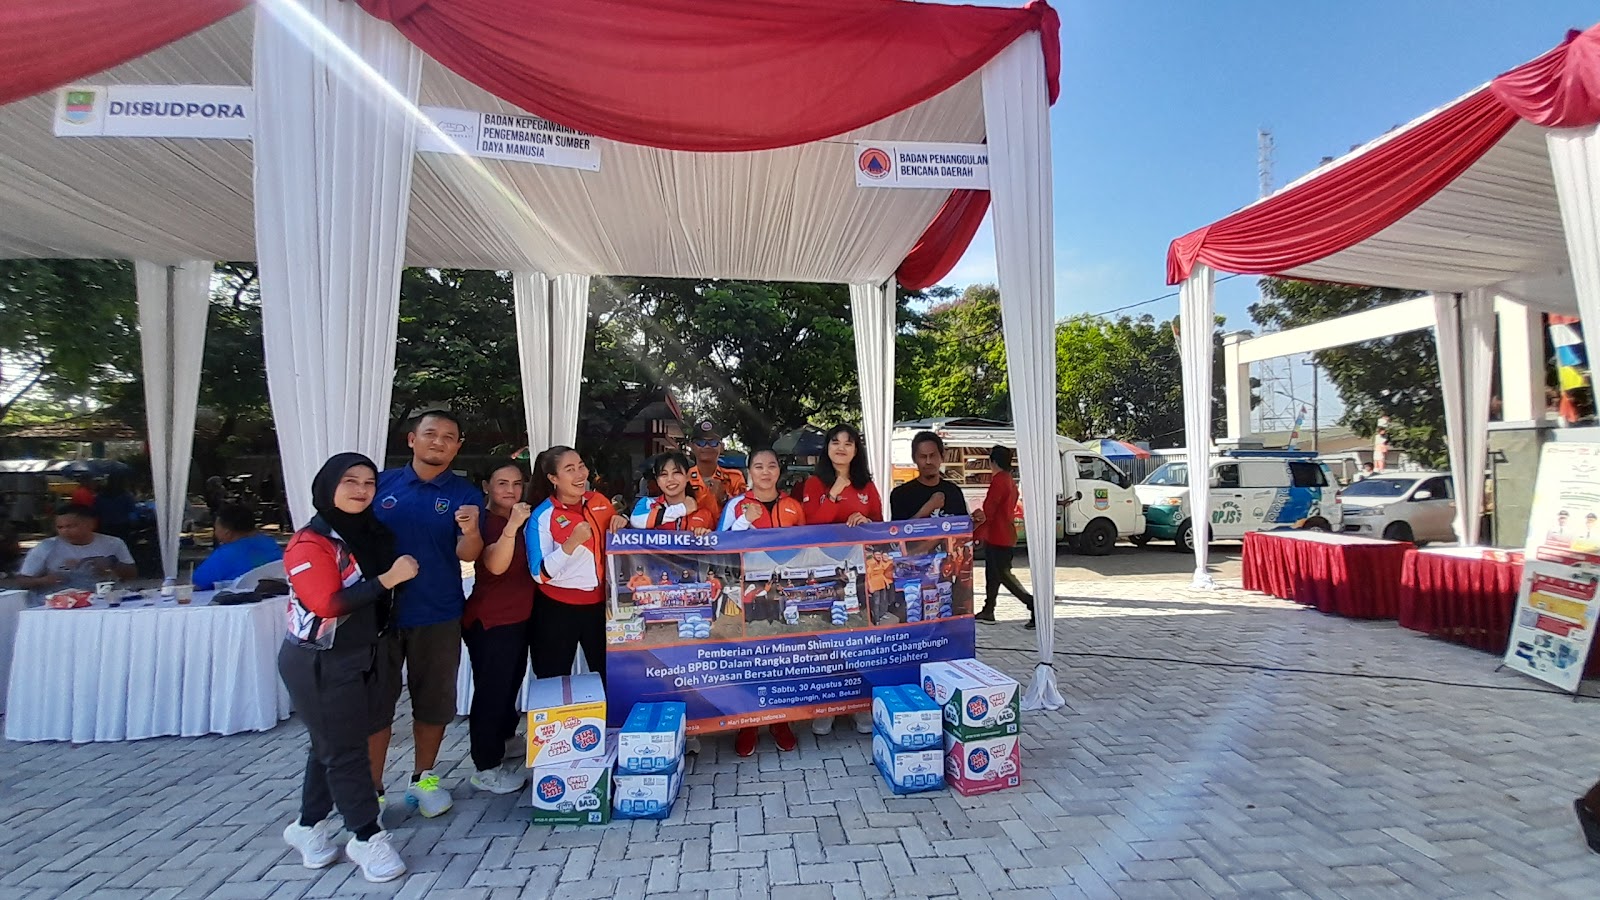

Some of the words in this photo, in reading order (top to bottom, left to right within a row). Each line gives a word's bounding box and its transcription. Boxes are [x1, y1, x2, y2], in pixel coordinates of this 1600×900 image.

[109, 101, 246, 118] DISBUDPORA
[485, 113, 514, 126] BADAN
[516, 116, 576, 135] KEPEGAWAIAN
[483, 128, 553, 145] PENGEMBANGAN
[555, 136, 590, 150] SUMBER
[482, 141, 504, 154] DAYA
[506, 143, 545, 158] MANUSIA
[900, 153, 928, 164] BADAN
[901, 166, 939, 176] BENCANA
[941, 167, 973, 177] DAERAH
[611, 533, 643, 545] AKSI
[646, 534, 671, 545] MBI
[674, 534, 718, 546] KE-313
[698, 647, 753, 659] Pemberian
[754, 645, 770, 655] Air
[772, 643, 806, 653] Minum
[808, 637, 844, 650] Shimizu
[846, 637, 863, 647] dan
[865, 635, 882, 645] Mie
[884, 632, 910, 642] Instan
[646, 665, 686, 678] Kepada
[688, 660, 718, 673] BPBD
[720, 658, 752, 669] Dalam
[754, 655, 791, 668] Rangka
[793, 653, 828, 664] Botram
[830, 650, 839, 660] di
[841, 646, 890, 658] Kecamatan
[892, 637, 949, 652] Cabangbungin
[674, 675, 699, 687] Oleh
[701, 672, 742, 684] Yayasan
[745, 668, 783, 679] Bersatu
[785, 662, 843, 676] Membangun
[845, 657, 888, 670] Indonesia
[889, 652, 929, 665] Sejahtera
[771, 685, 797, 694] Sabtu,
[810, 681, 842, 691] Agustus
[844, 678, 862, 686] 2025
[839, 689, 861, 697] Bekasi
[968, 698, 983, 709] POP
[762, 713, 786, 721] Indonesia
[999, 713, 1013, 721] BASO
[575, 728, 593, 743] MIE
[581, 733, 597, 748] POP
[544, 786, 563, 798] MIE
